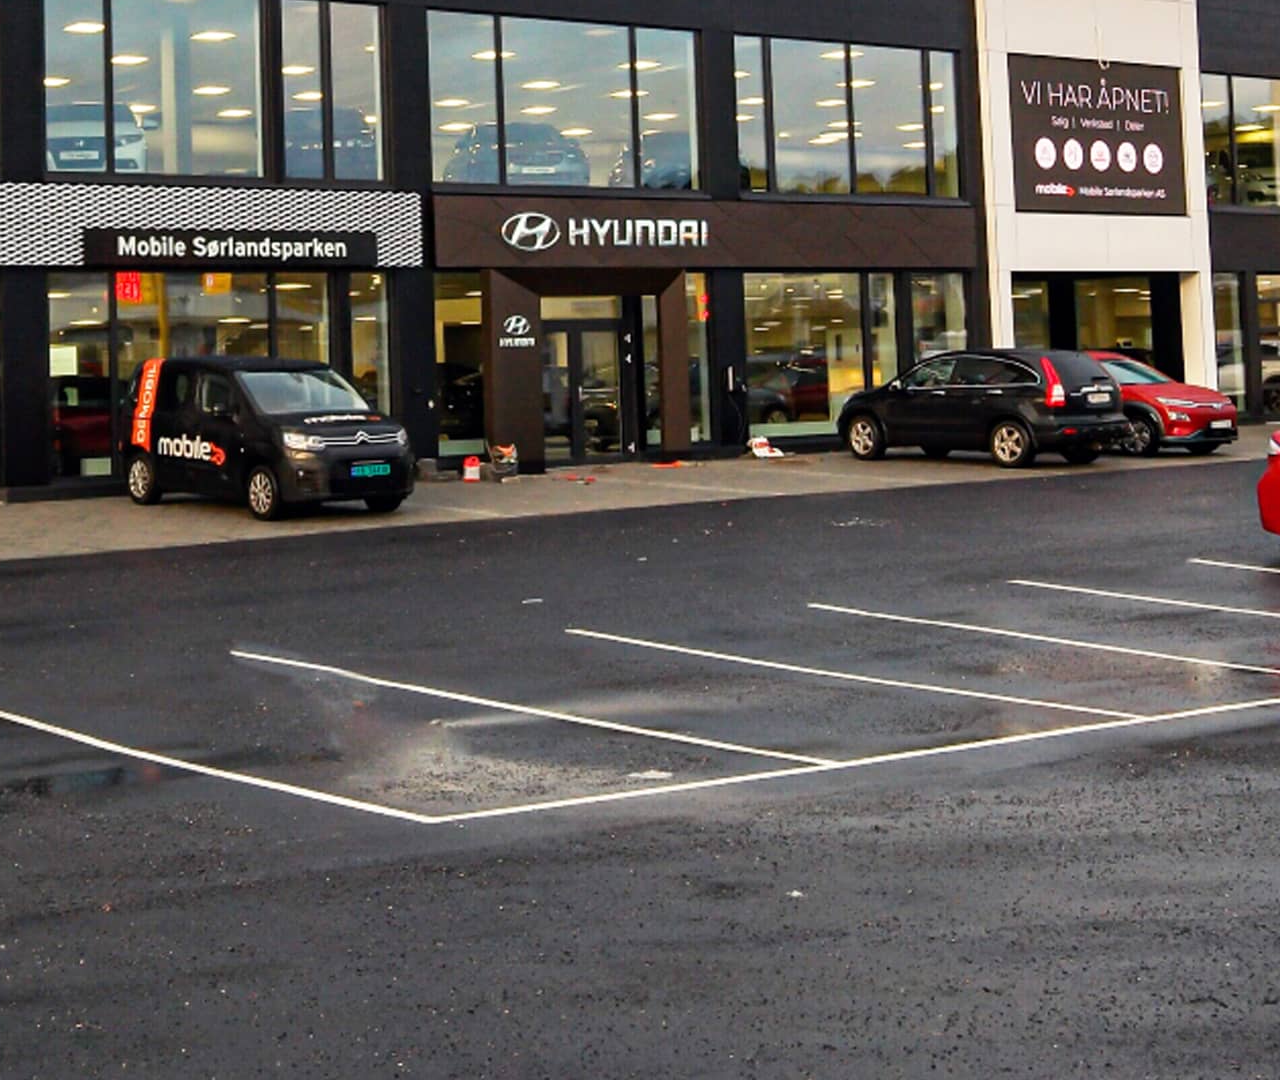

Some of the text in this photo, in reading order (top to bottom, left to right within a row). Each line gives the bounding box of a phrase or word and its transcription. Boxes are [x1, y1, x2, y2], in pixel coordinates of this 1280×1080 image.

[1020, 77, 1170, 115] VI HAR ÅPNET!
[568, 218, 709, 247] HYUNDAI
[117, 235, 348, 262] Mobile Sørlandsparken
[157, 432, 212, 461] mobile
